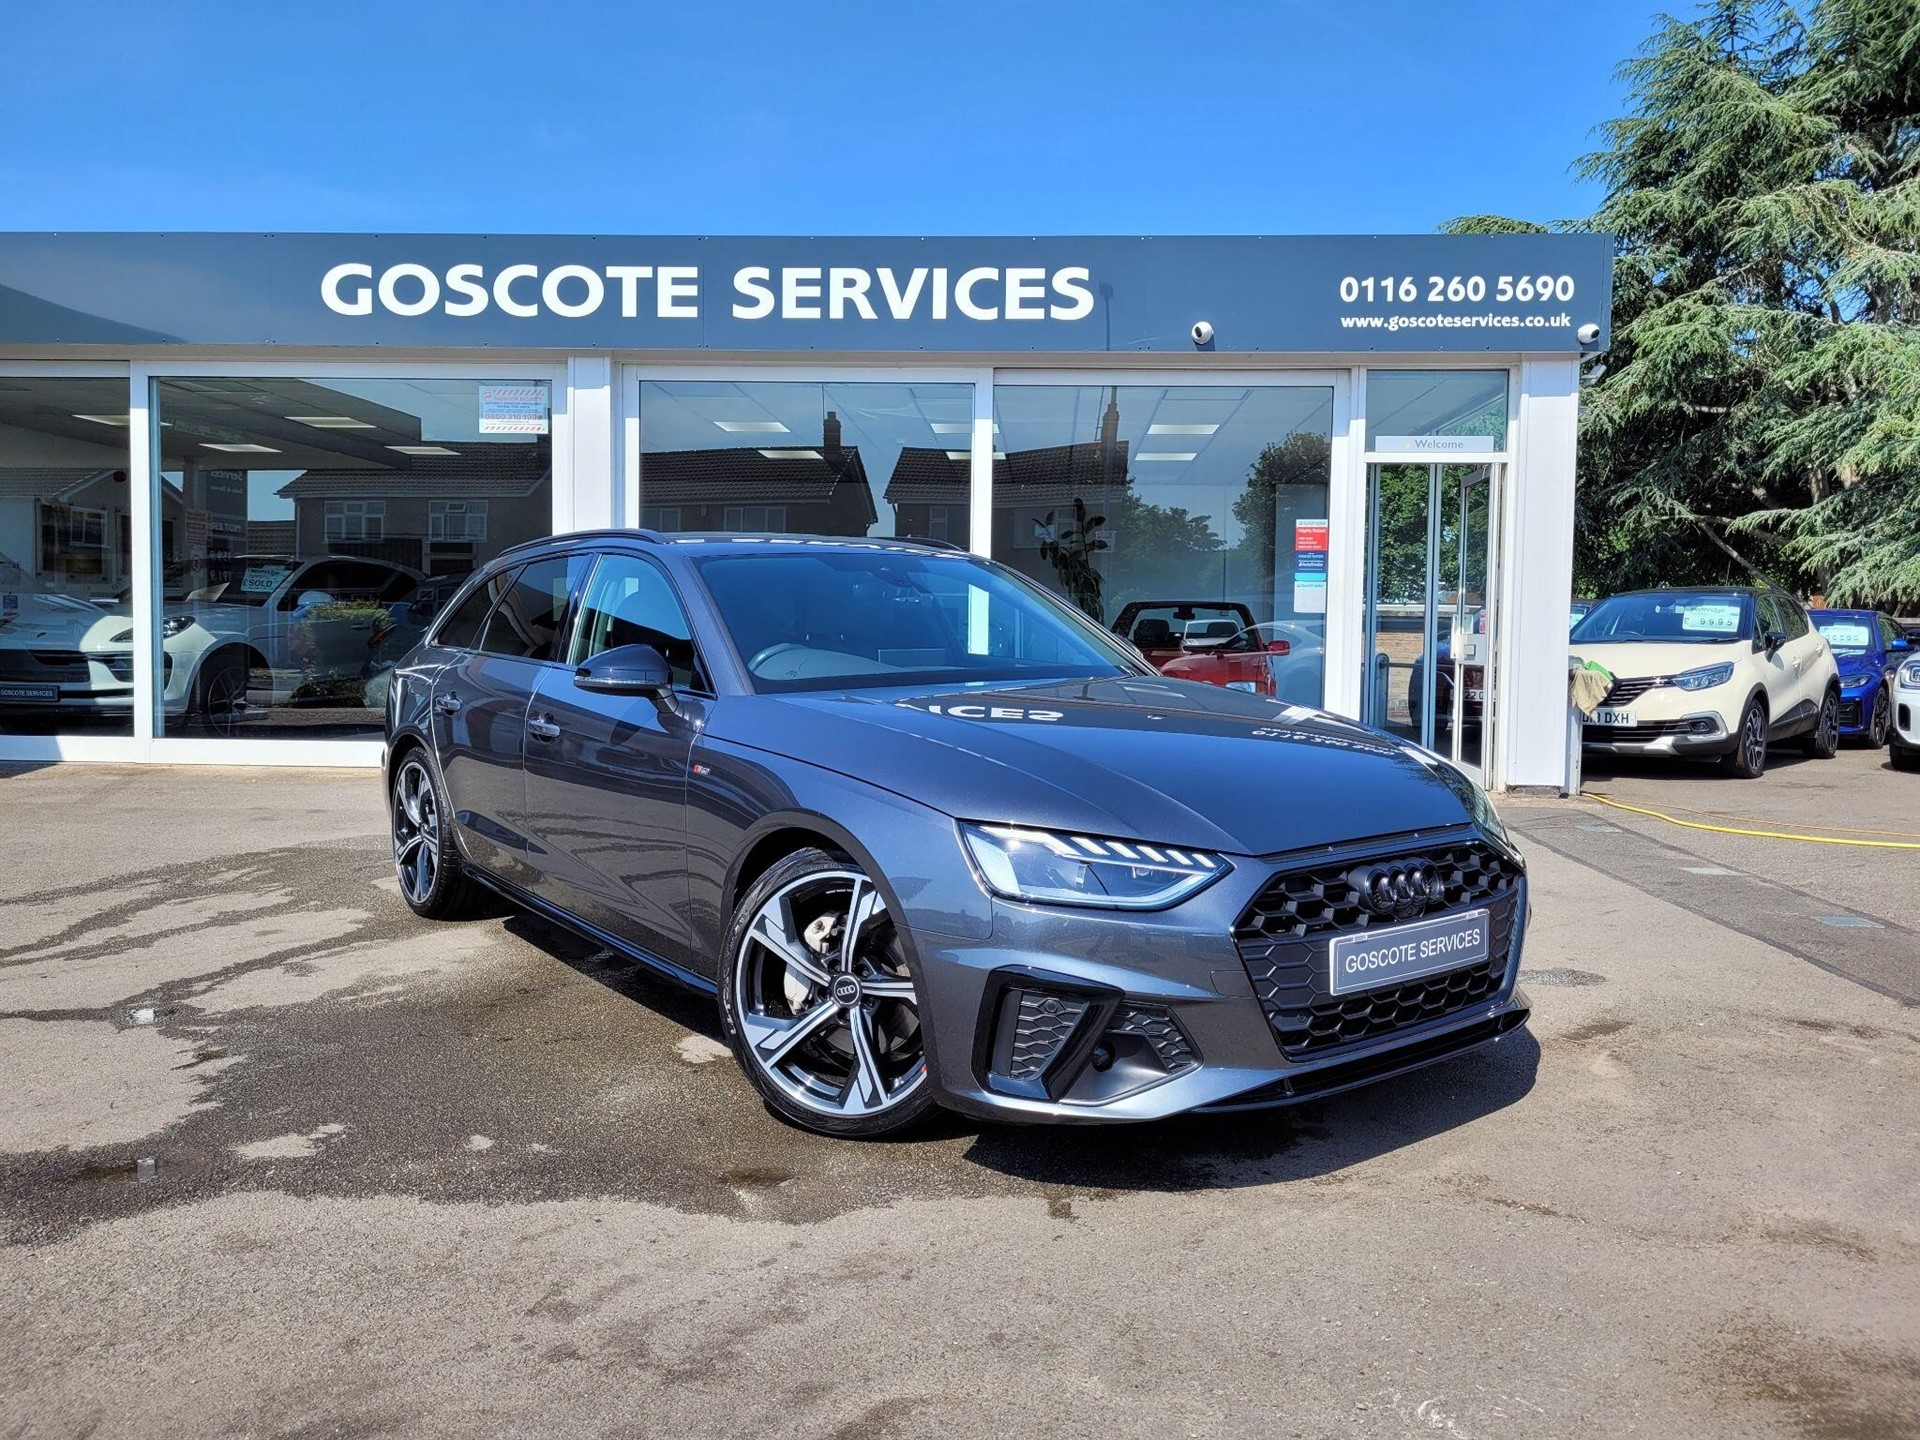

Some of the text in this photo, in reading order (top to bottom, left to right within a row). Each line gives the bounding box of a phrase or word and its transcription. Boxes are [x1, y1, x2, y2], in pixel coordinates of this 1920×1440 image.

[320, 262, 1095, 321] GOSCOTE SERVICES
[1340, 275, 1575, 302] 0116 260 5690
[1340, 312, 1571, 332] www.goscoteservices.co.uk
[1415, 439, 1464, 449] Welcome
[249, 579, 273, 587] SOLD
[1700, 618, 1733, 626] 9995
[1, 689, 26, 697] GOSCOTE
[1604, 711, 1629, 724] DXH
[1346, 928, 1481, 973] GOSCOTE SERVICES
